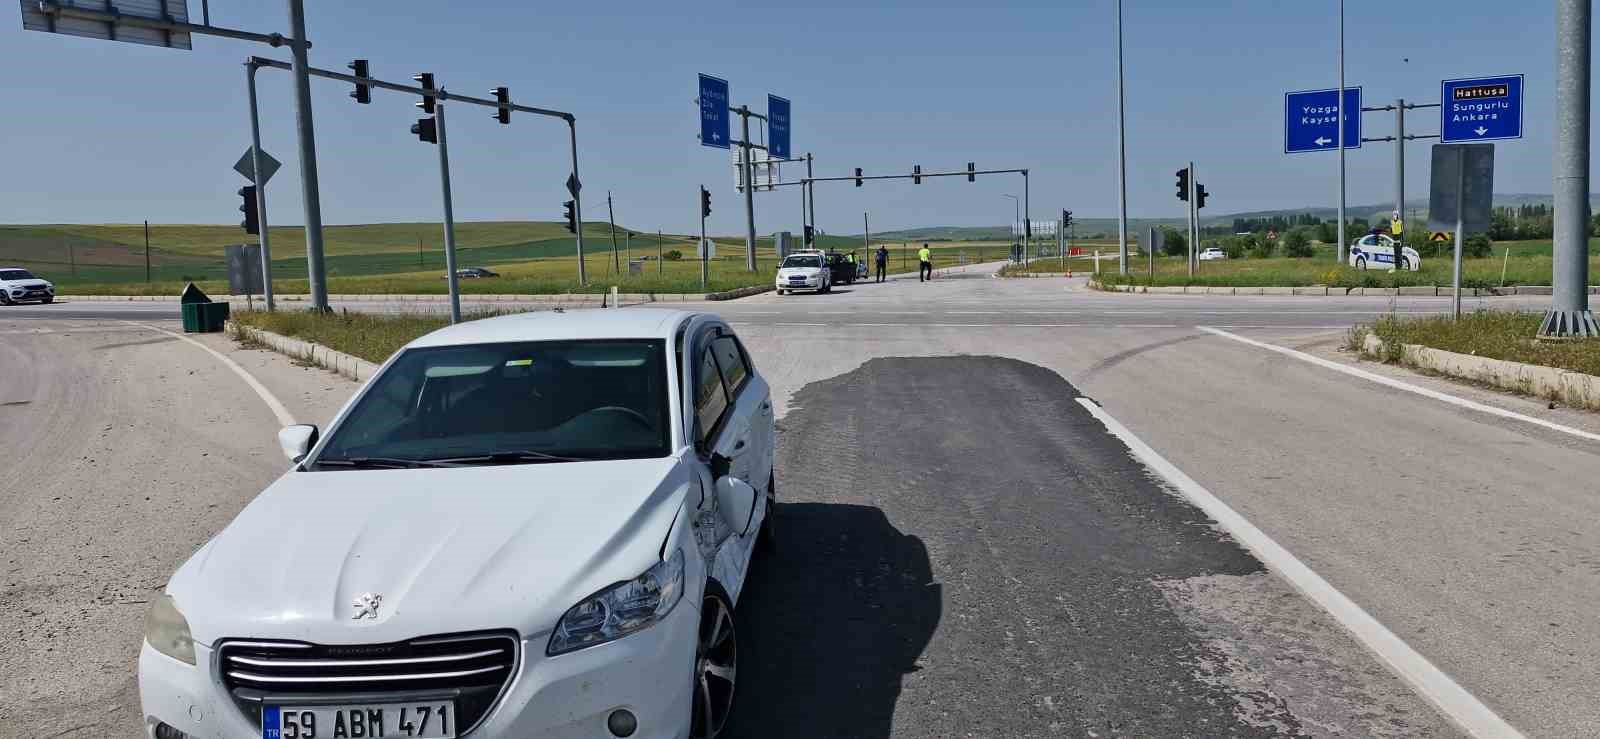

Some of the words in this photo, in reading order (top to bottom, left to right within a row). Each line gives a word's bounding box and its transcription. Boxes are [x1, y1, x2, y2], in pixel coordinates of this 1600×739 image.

[1303, 106, 1338, 114] Yozga
[1453, 101, 1508, 112] Sungurlu
[1302, 114, 1347, 125] Kaysei
[1453, 113, 1497, 122] Ankara
[284, 712, 315, 739] 59
[333, 709, 384, 739] ABM
[399, 705, 448, 737] 471
